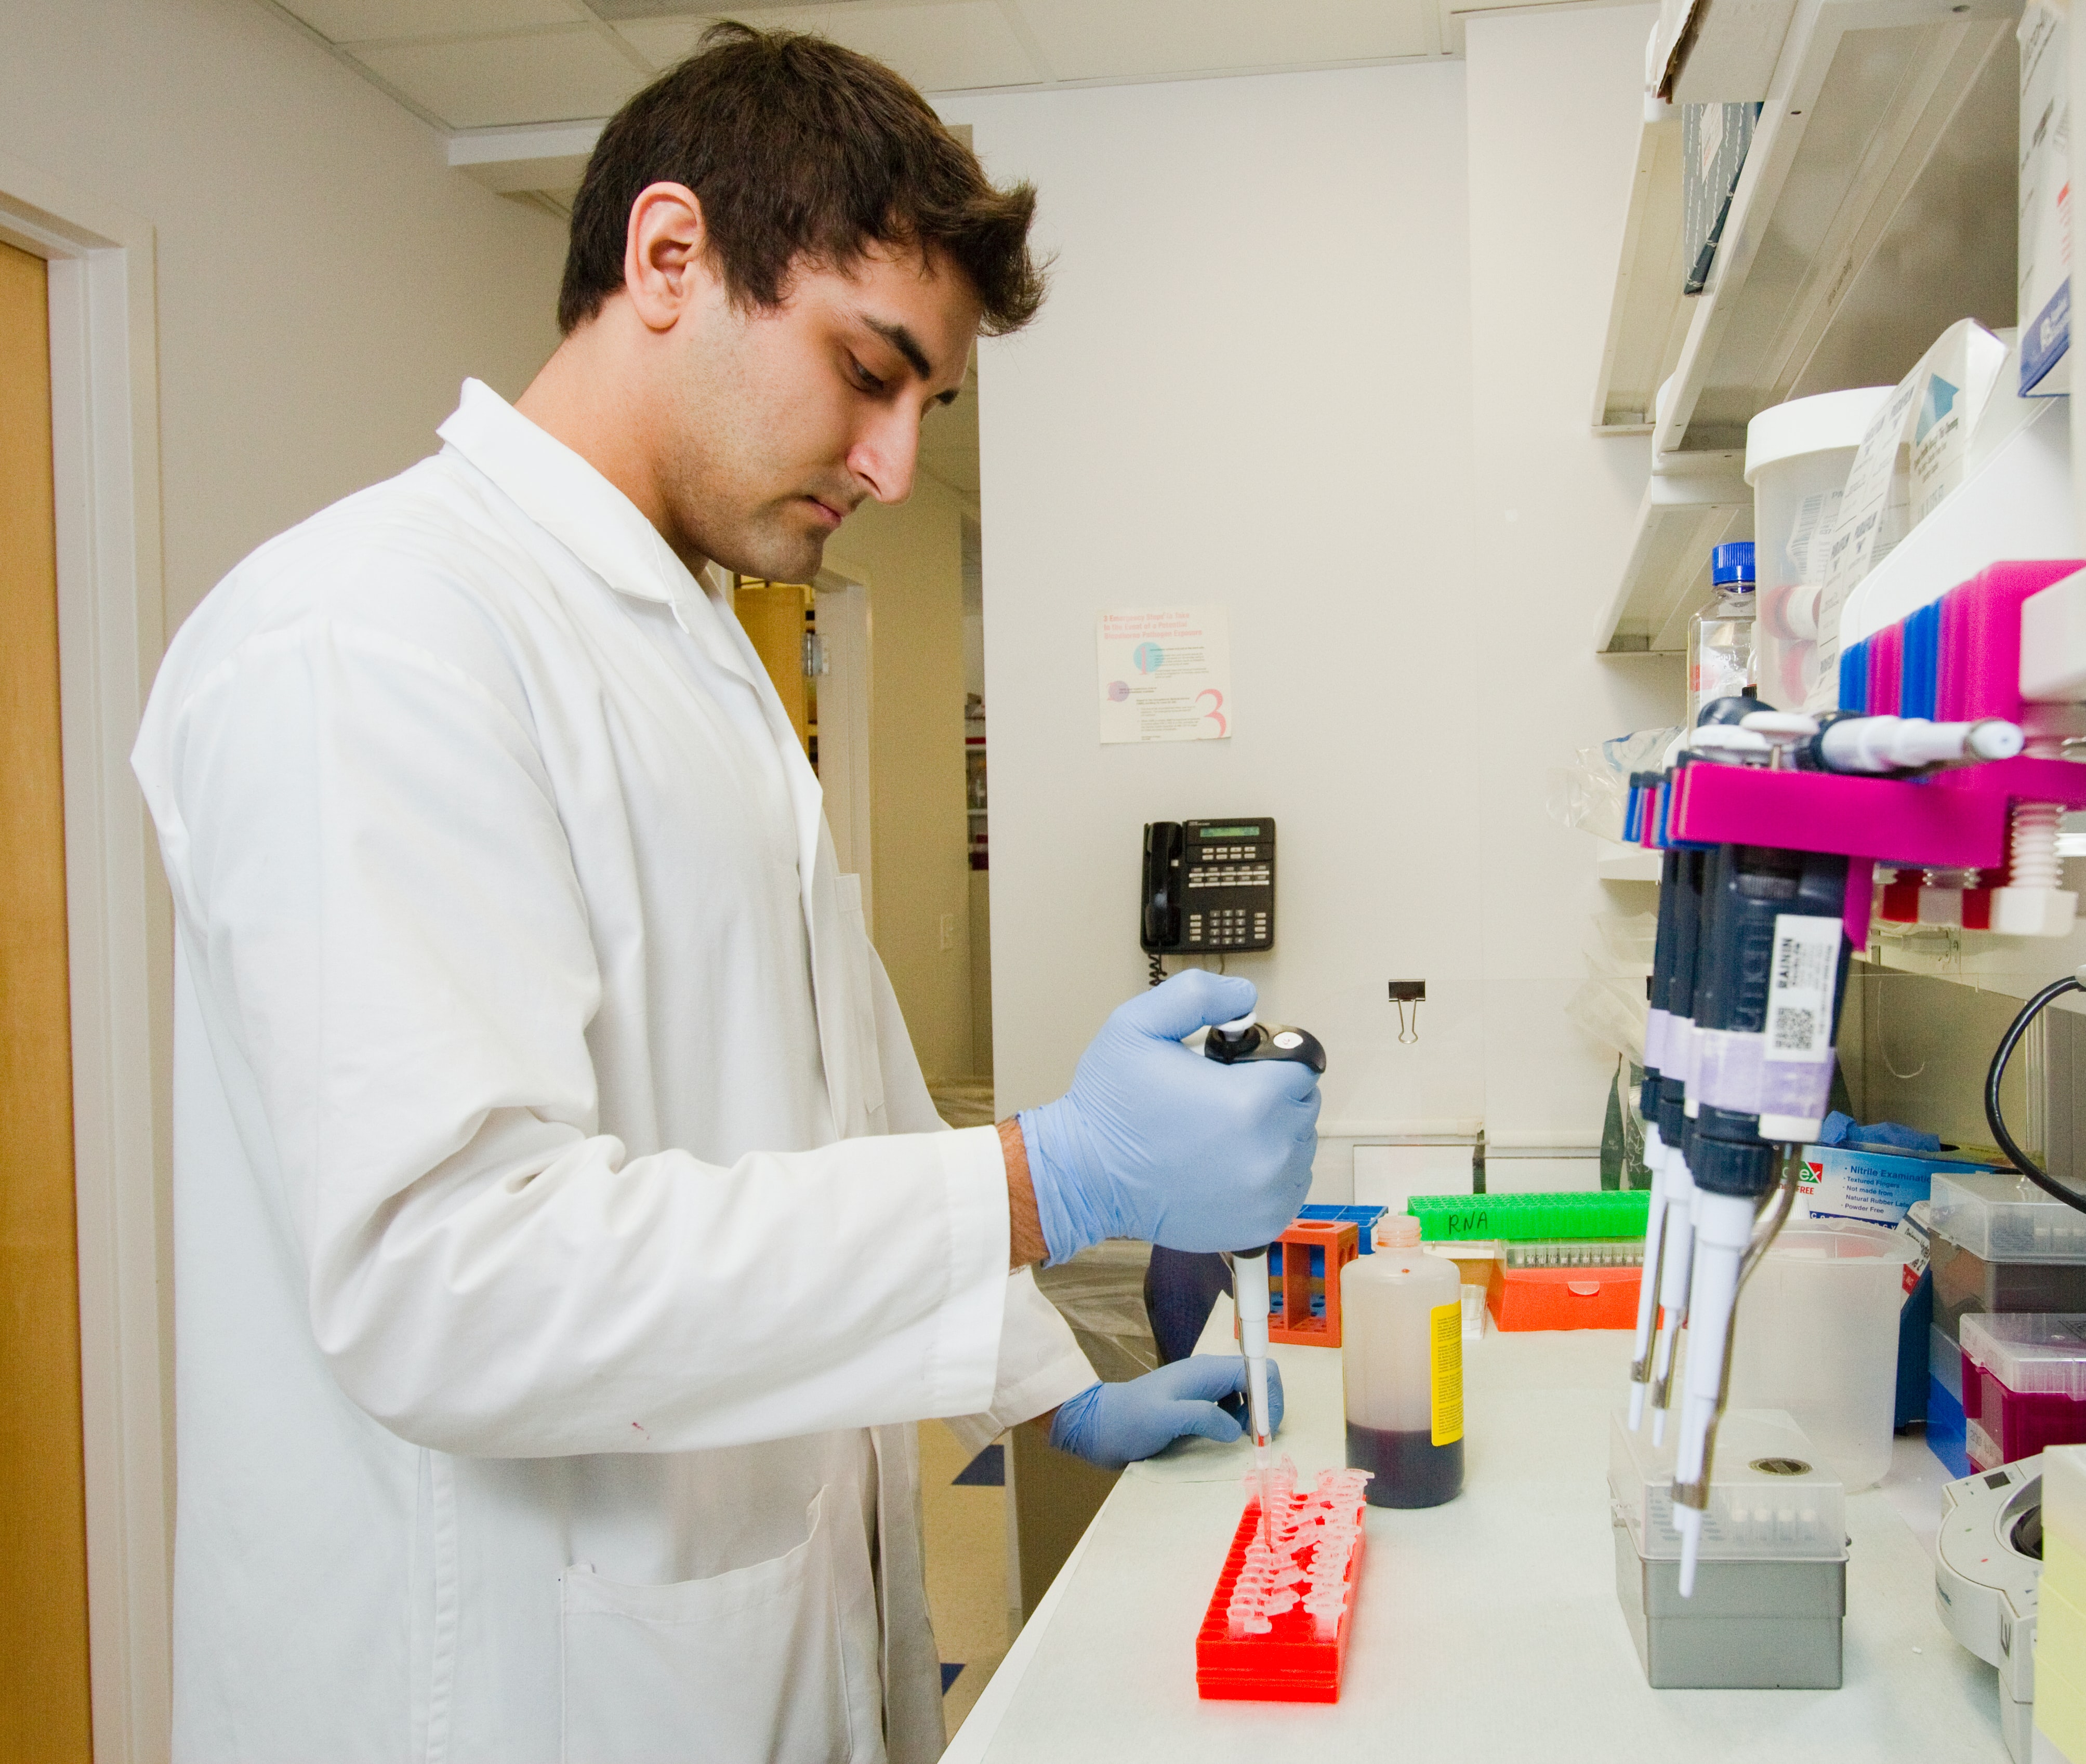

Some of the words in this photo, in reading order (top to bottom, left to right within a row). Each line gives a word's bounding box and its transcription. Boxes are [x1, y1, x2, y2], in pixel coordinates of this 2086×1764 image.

[1777, 937, 1792, 989] RAININ
[1850, 1165, 1878, 1176] Nitrile
[1880, 1170, 1931, 1183] Examinatio
[1847, 1176, 1875, 1185] Textured
[1876, 1179, 1900, 1188] Fingers
[1845, 1194, 1869, 1203] Natural
[1870, 1197, 1894, 1206] Rubber
[1844, 1203, 1868, 1212] Powder
[1448, 1211, 1488, 1235] RNA
[1525, 1254, 1560, 1264] CORNING
